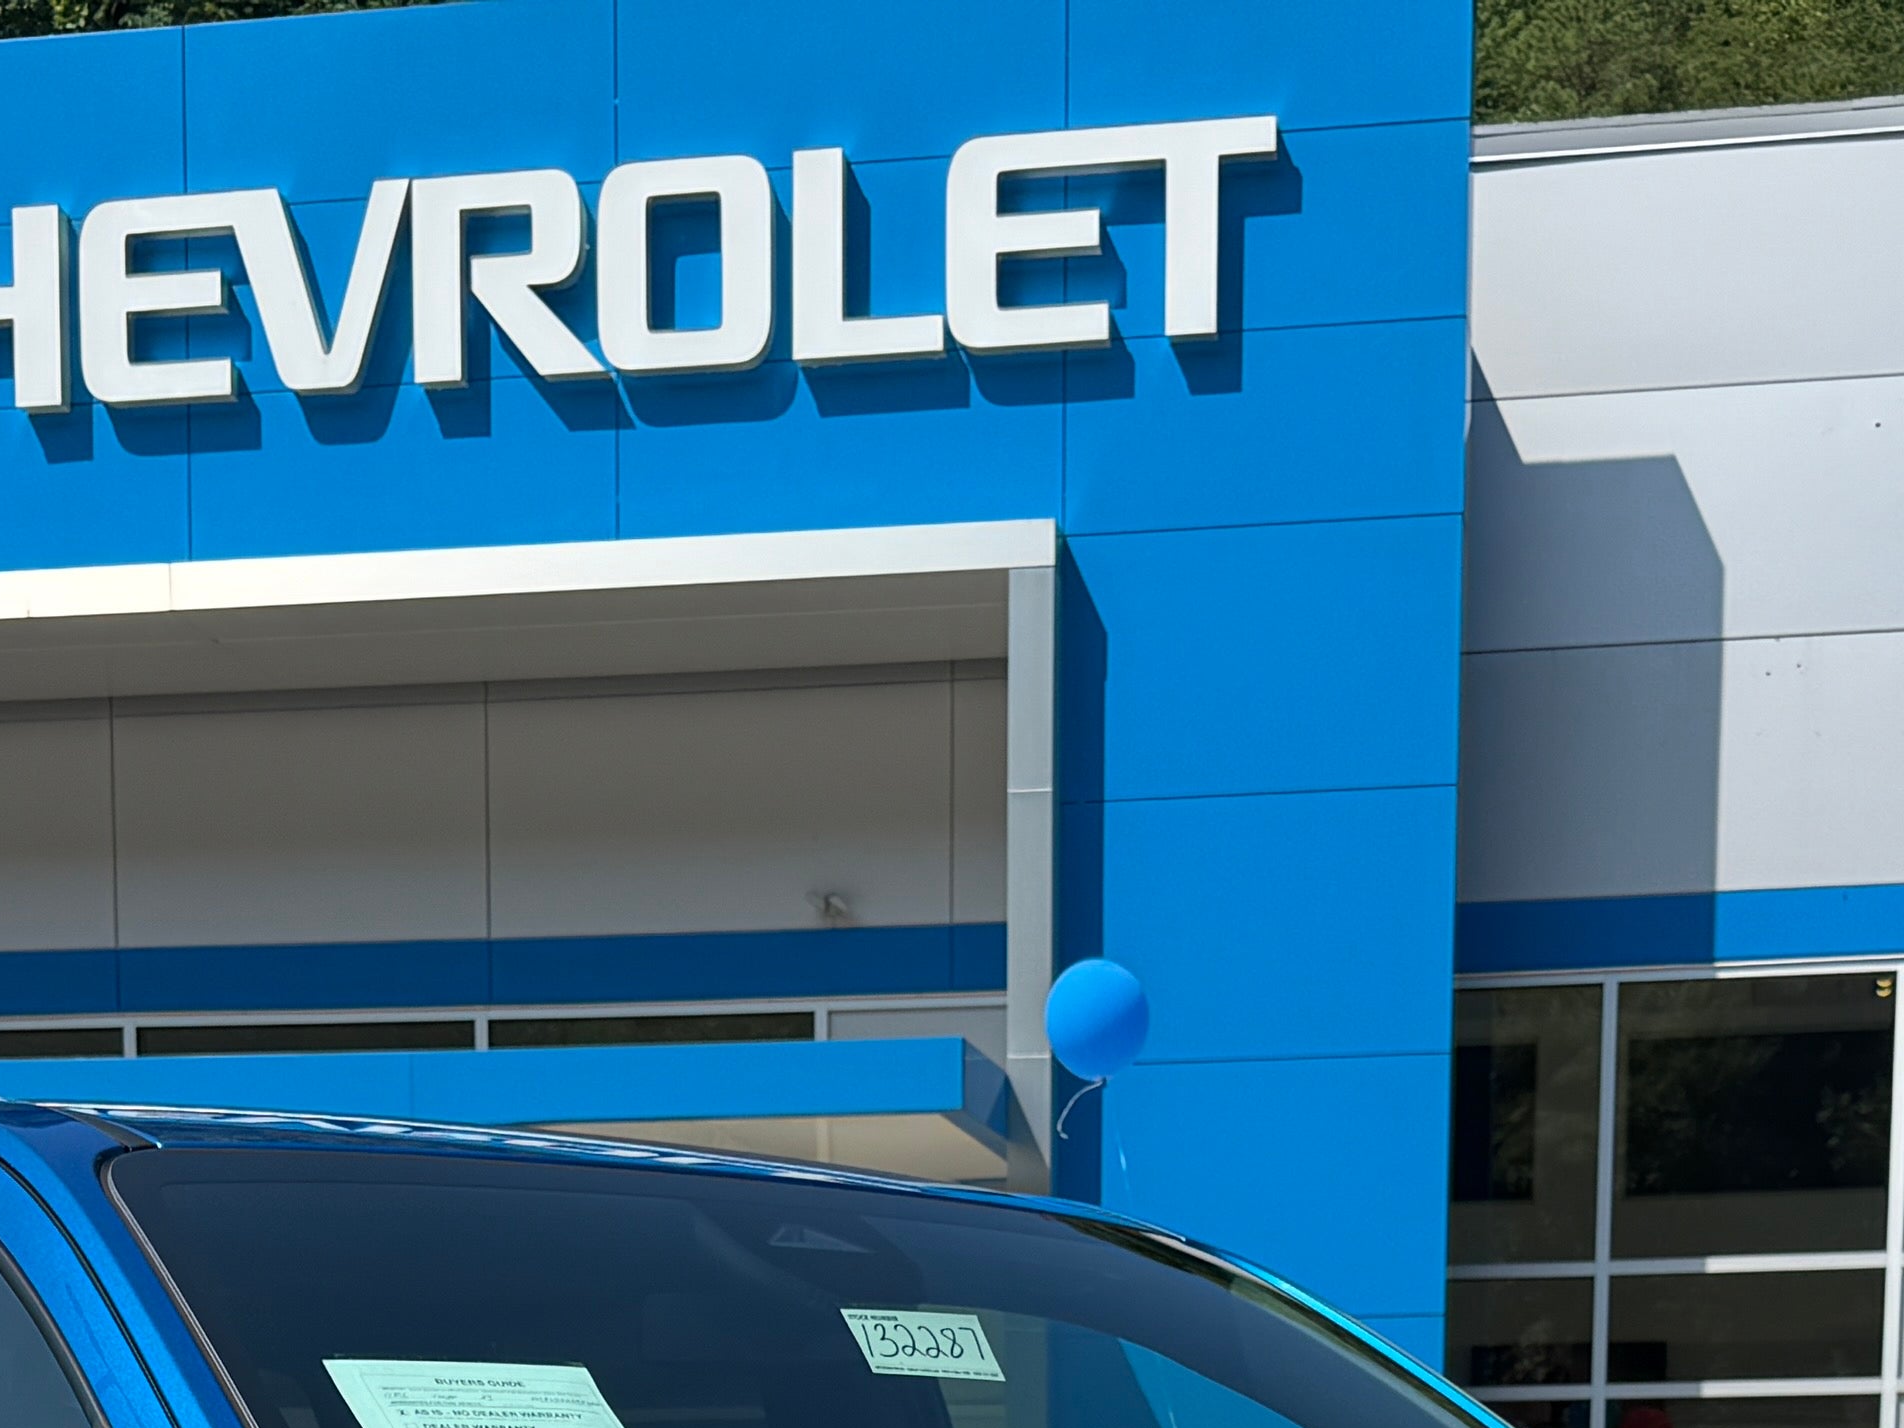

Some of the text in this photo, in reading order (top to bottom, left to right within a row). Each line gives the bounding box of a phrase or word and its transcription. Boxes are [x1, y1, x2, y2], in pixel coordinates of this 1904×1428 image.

[861, 1323, 985, 1360] 132287
[434, 1377, 526, 1388] BUYERS GUIDE
[472, 1411, 519, 1419] DEALER
[519, 1412, 583, 1420] WARRANTY
